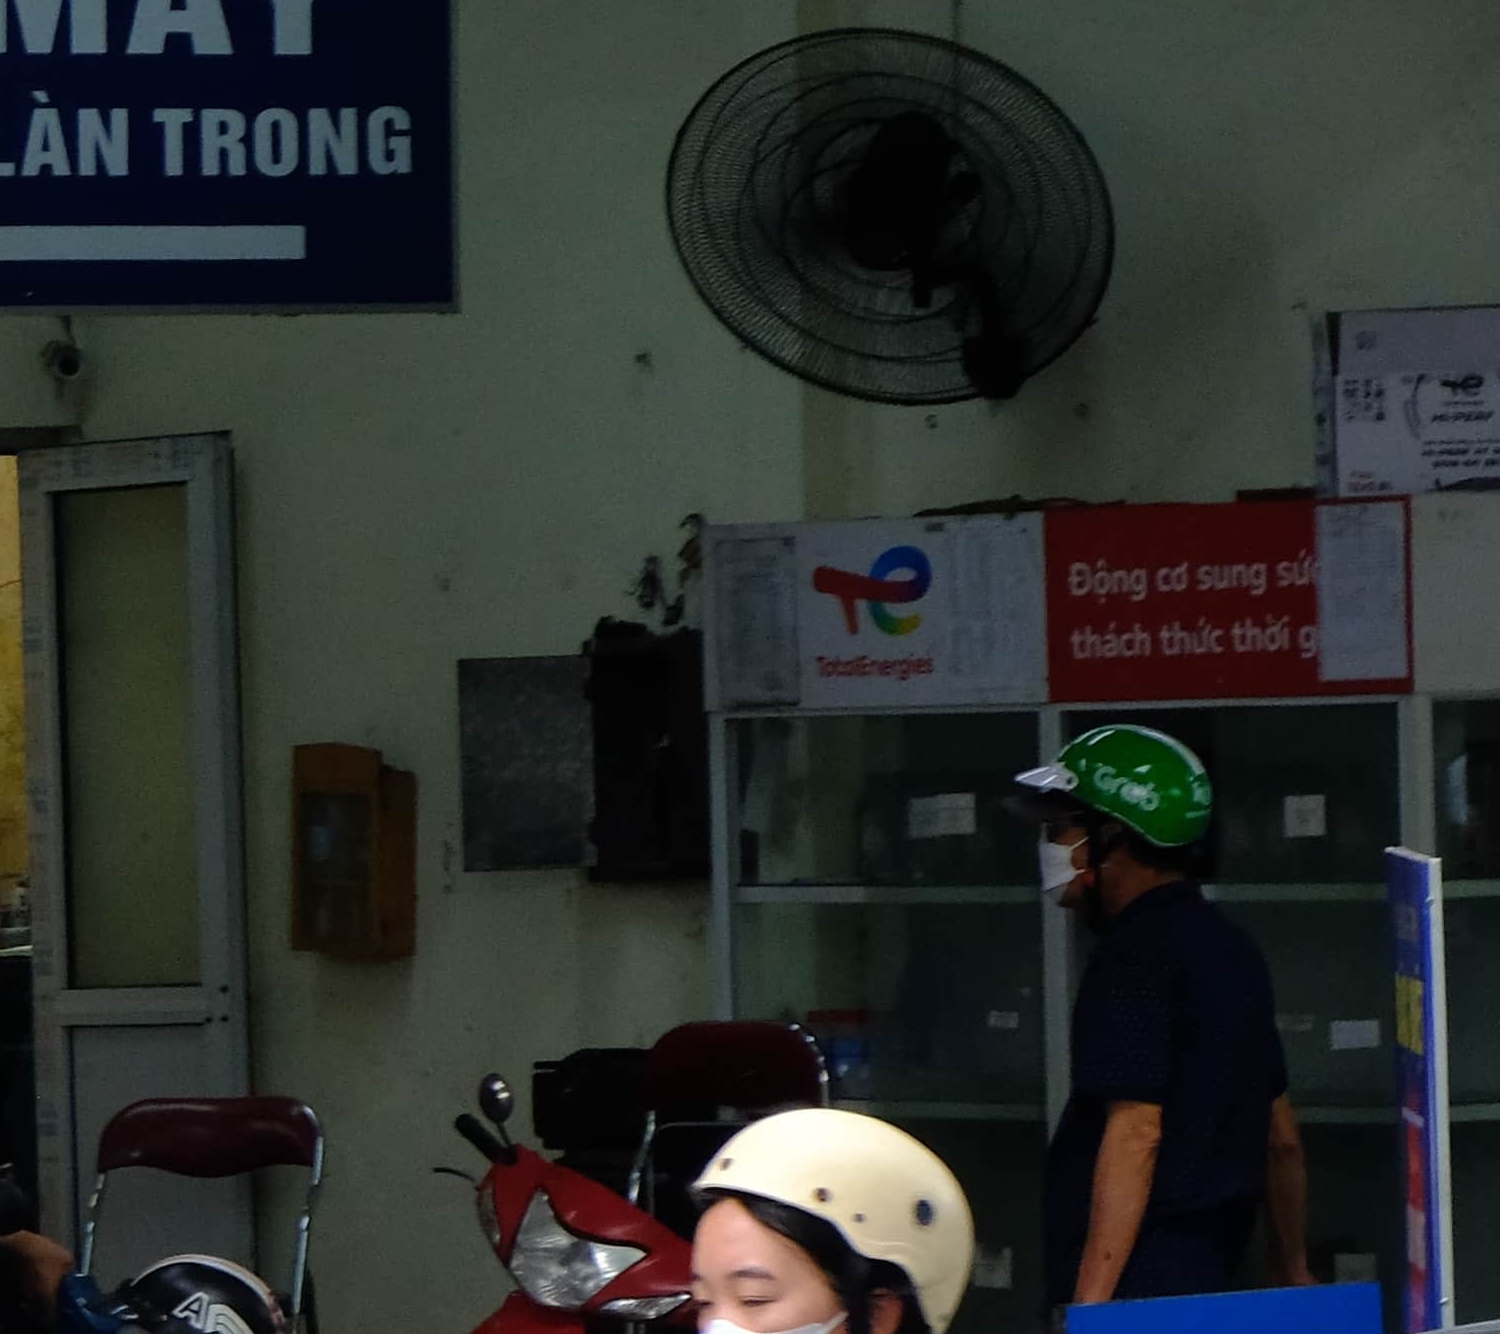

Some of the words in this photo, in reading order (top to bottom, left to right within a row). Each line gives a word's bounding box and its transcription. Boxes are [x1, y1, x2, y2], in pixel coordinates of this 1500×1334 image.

[153, 105, 414, 178] TRONG
[1067, 558, 1148, 605] Động
[1155, 561, 1189, 593] cơ
[1195, 560, 1269, 597] sung
[1069, 620, 1153, 660] thách
[1158, 616, 1226, 657] thức
[1298, 624, 1320, 658] g
[1093, 763, 1163, 812] Grab
